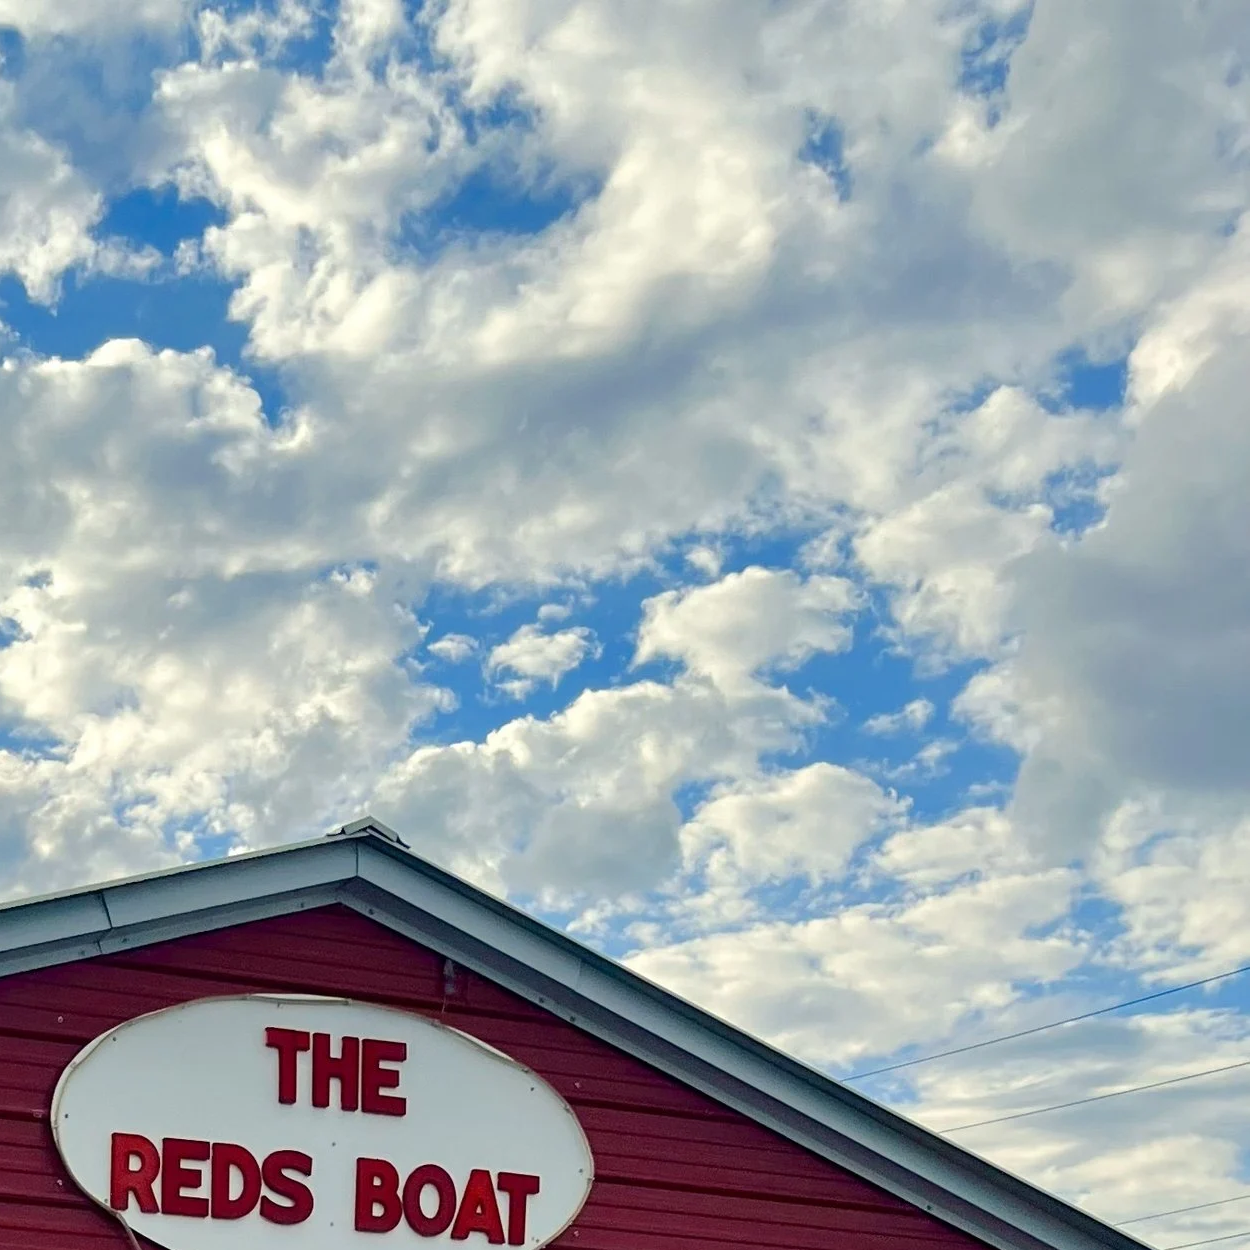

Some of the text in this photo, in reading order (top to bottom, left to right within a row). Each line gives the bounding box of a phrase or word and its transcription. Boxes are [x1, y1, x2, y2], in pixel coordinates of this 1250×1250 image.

[264, 1026, 407, 1117] THE
[109, 1132, 540, 1246] REDS BOAT
